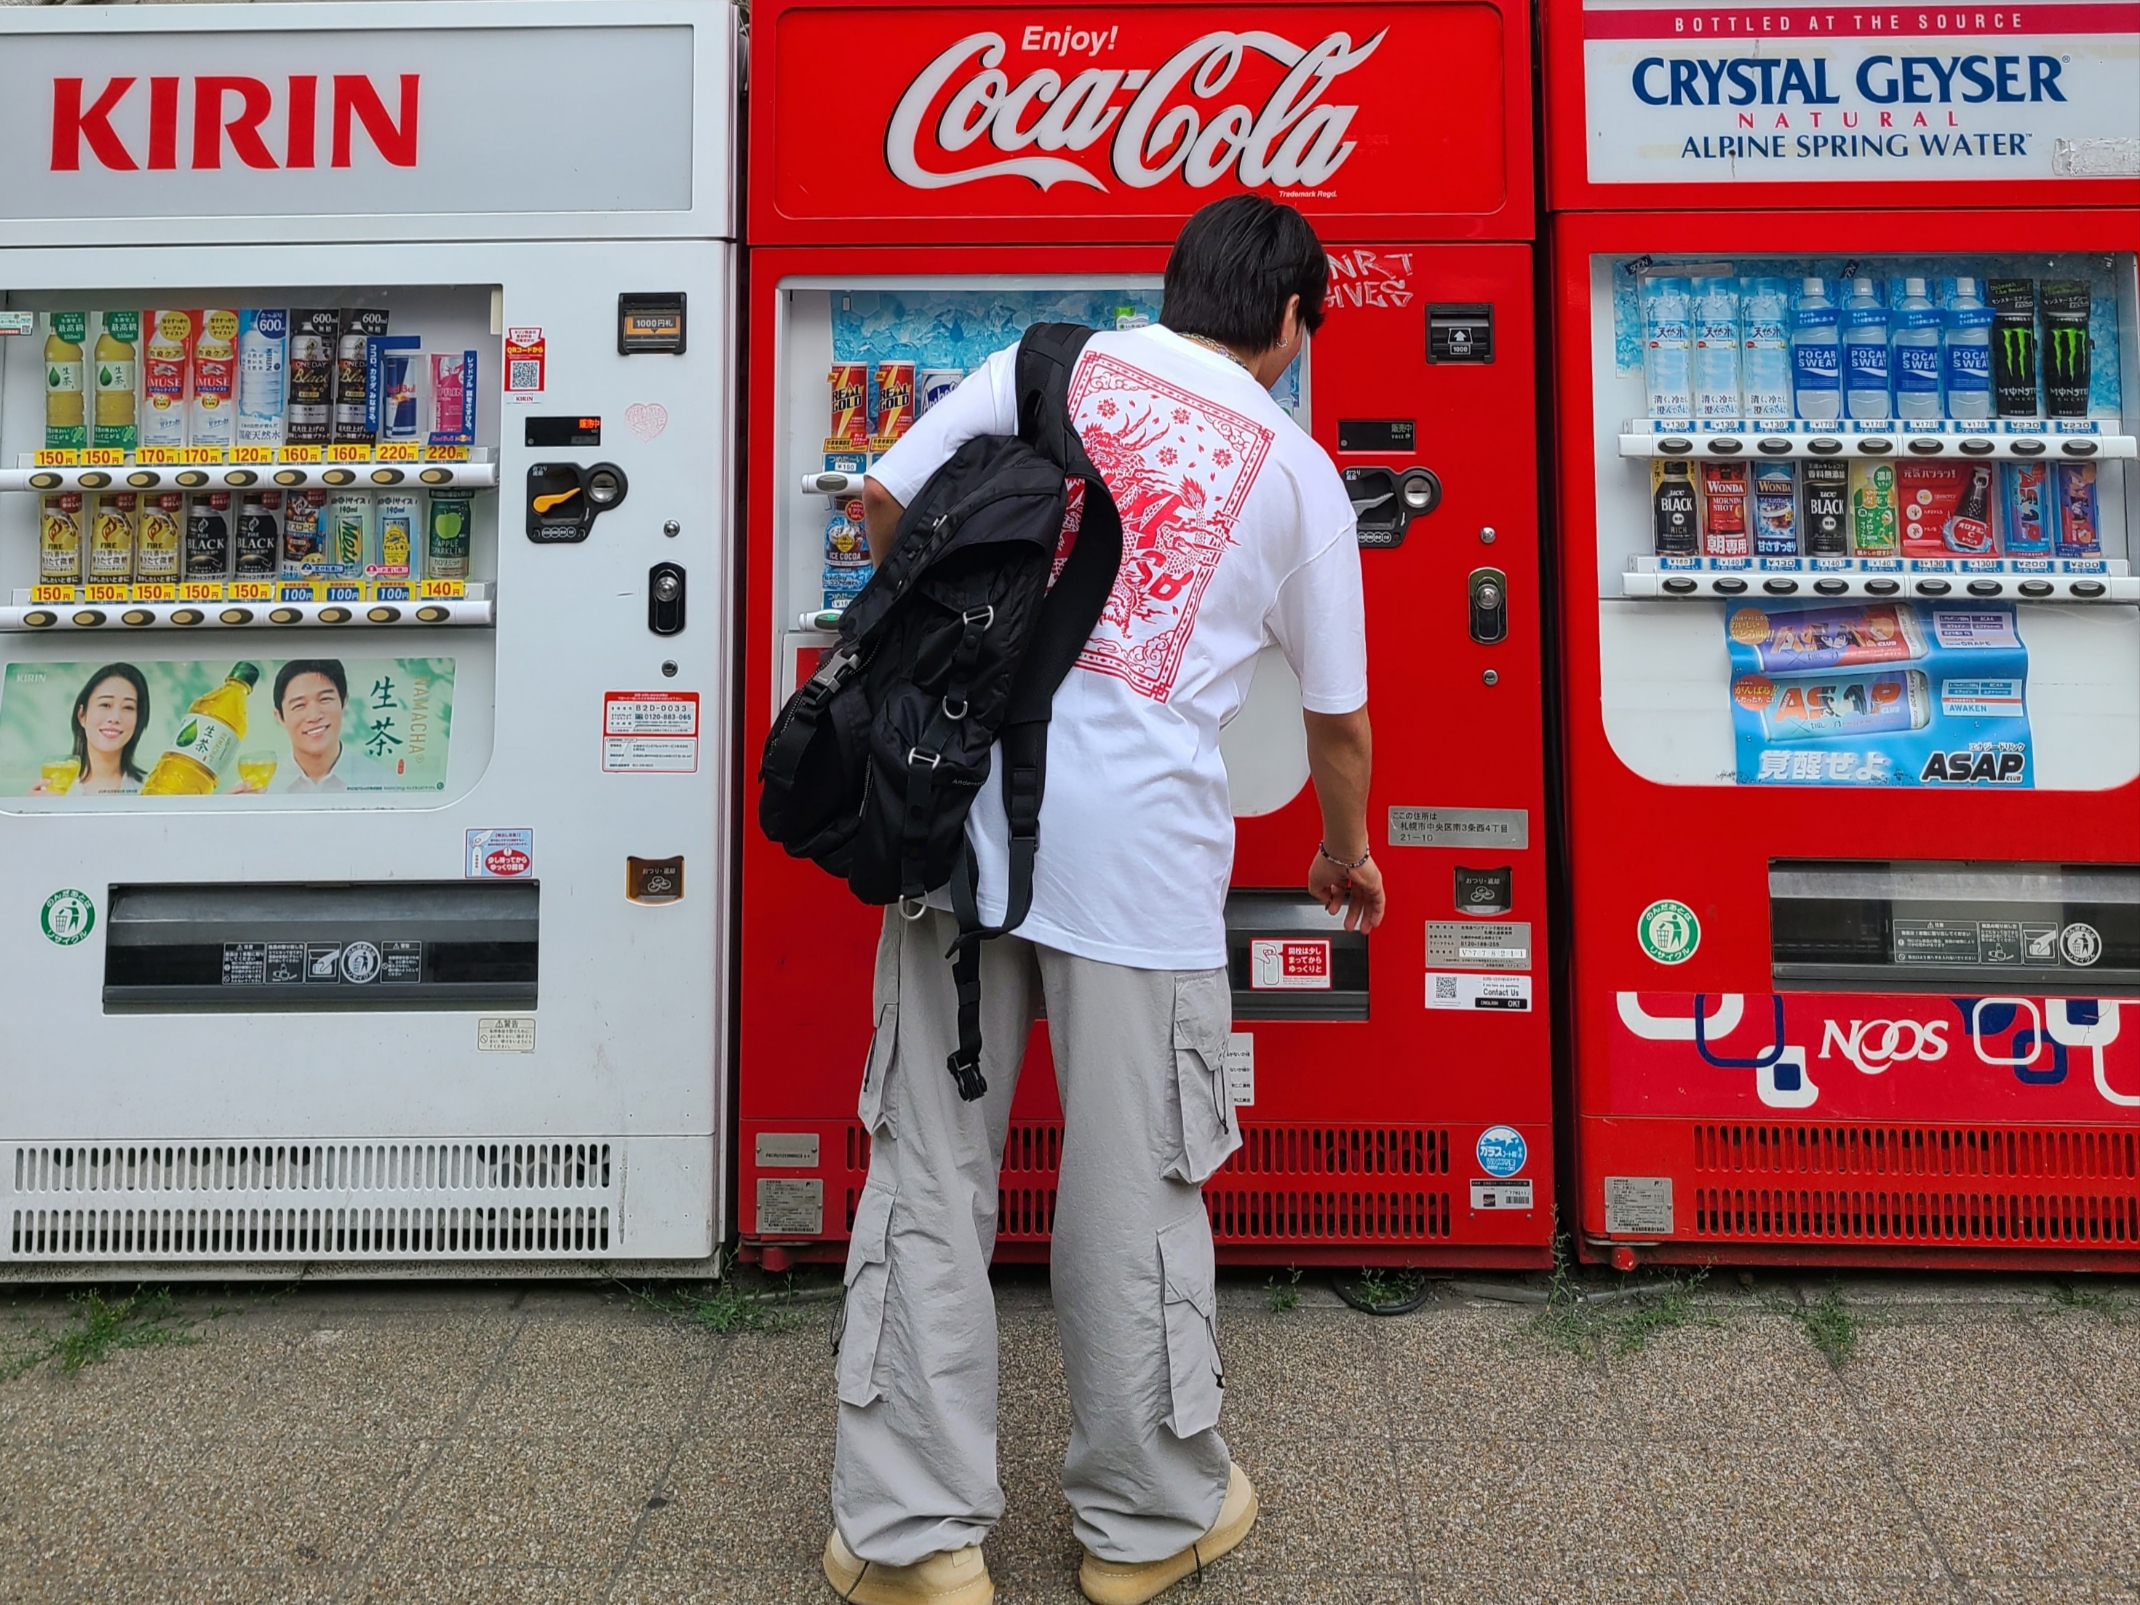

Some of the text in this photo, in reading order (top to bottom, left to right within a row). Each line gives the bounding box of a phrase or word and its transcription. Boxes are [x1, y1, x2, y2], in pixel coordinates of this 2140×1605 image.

[1675, 13, 2023, 32] BOTTLED AT THE SOURCE
[1021, 26, 1118, 57] Enjoy!
[1632, 56, 1840, 106] CRYSTAL
[885, 24, 1391, 193] Coca-Cola
[49, 74, 421, 172] KIRIN
[1738, 110, 1960, 129] NATURAL
[1680, 134, 1786, 159] ALPINE
[1796, 134, 1909, 158] SPRING
[1279, 190, 1338, 199] Trademark Regd.
[636, 319, 674, 328] 1000円札
[1656, 326, 1684, 339] 天然水
[1704, 326, 1733, 339] 天然水
[1752, 326, 1781, 339] 天然水
[62, 366, 73, 386] 生茶
[114, 366, 125, 386] 生茶
[832, 383, 863, 400] REAL
[880, 383, 910, 400] REAL
[832, 393, 862, 413] GOLD
[879, 394, 909, 412] GOLD
[1391, 423, 1413, 433] 販売中
[39, 452, 73, 464] 150円
[85, 451, 119, 464] 150円
[140, 449, 174, 463] 170円
[184, 449, 218, 463] 170円
[234, 448, 268, 462] 120円
[283, 448, 318, 462] 160円
[332, 447, 366, 461] 160円
[379, 446, 415, 460] 220円
[428, 445, 463, 459] 220円
[1807, 470, 1845, 479] 香料無添加
[1706, 480, 1744, 493] WONDA
[1758, 480, 1792, 493] WONDA
[1661, 498, 1693, 512] BLACK
[1713, 504, 1734, 512] SHOT
[1810, 499, 1844, 515] BLACK
[1670, 526, 1688, 534] RICH
[187, 538, 225, 550] BLACK
[237, 537, 275, 549] BLACK
[339, 520, 359, 569] Mets
[1706, 534, 1747, 555] 朝専用
[1757, 540, 1797, 553] 甘さすっきり
[829, 552, 861, 560] ICE COCOA
[2071, 561, 2099, 569] ¥200
[36, 587, 71, 600] 150円
[89, 586, 124, 600] 150円
[137, 585, 171, 599] 150円
[185, 584, 219, 599] 150円
[234, 584, 268, 598] 150円
[284, 588, 313, 600] 100円
[330, 588, 359, 600] 100円
[380, 588, 409, 600] 100円
[426, 582, 460, 596] 140円
[16, 674, 47, 683] KIRIN
[1774, 682, 1901, 723] ASAP
[1949, 704, 1987, 713] AWAKEN
[365, 675, 404, 757] 生茶
[1880, 706, 1900, 715] CLUB
[1969, 742, 2025, 752] エナジードリンク
[1758, 750, 1890, 781] 覚醒せよ
[1921, 752, 2024, 781] ASAP
[1392, 812, 1437, 821] ここの住所は
[1400, 822, 1508, 834] 札幌市中央区南3条西4丁目
[46, 889, 93, 909] のんだあとは
[1646, 903, 1693, 922] のんだあとは
[46, 929, 88, 945] リサイクル
[1288, 946, 1322, 955] 開栓は少し
[1649, 945, 1690, 961] リサイクル
[1288, 956, 1322, 964] まってから
[1288, 965, 1322, 973] ゆっくりと
[1483, 988, 1519, 997] Contact Us
[1818, 1019, 1949, 1075] NOOS
